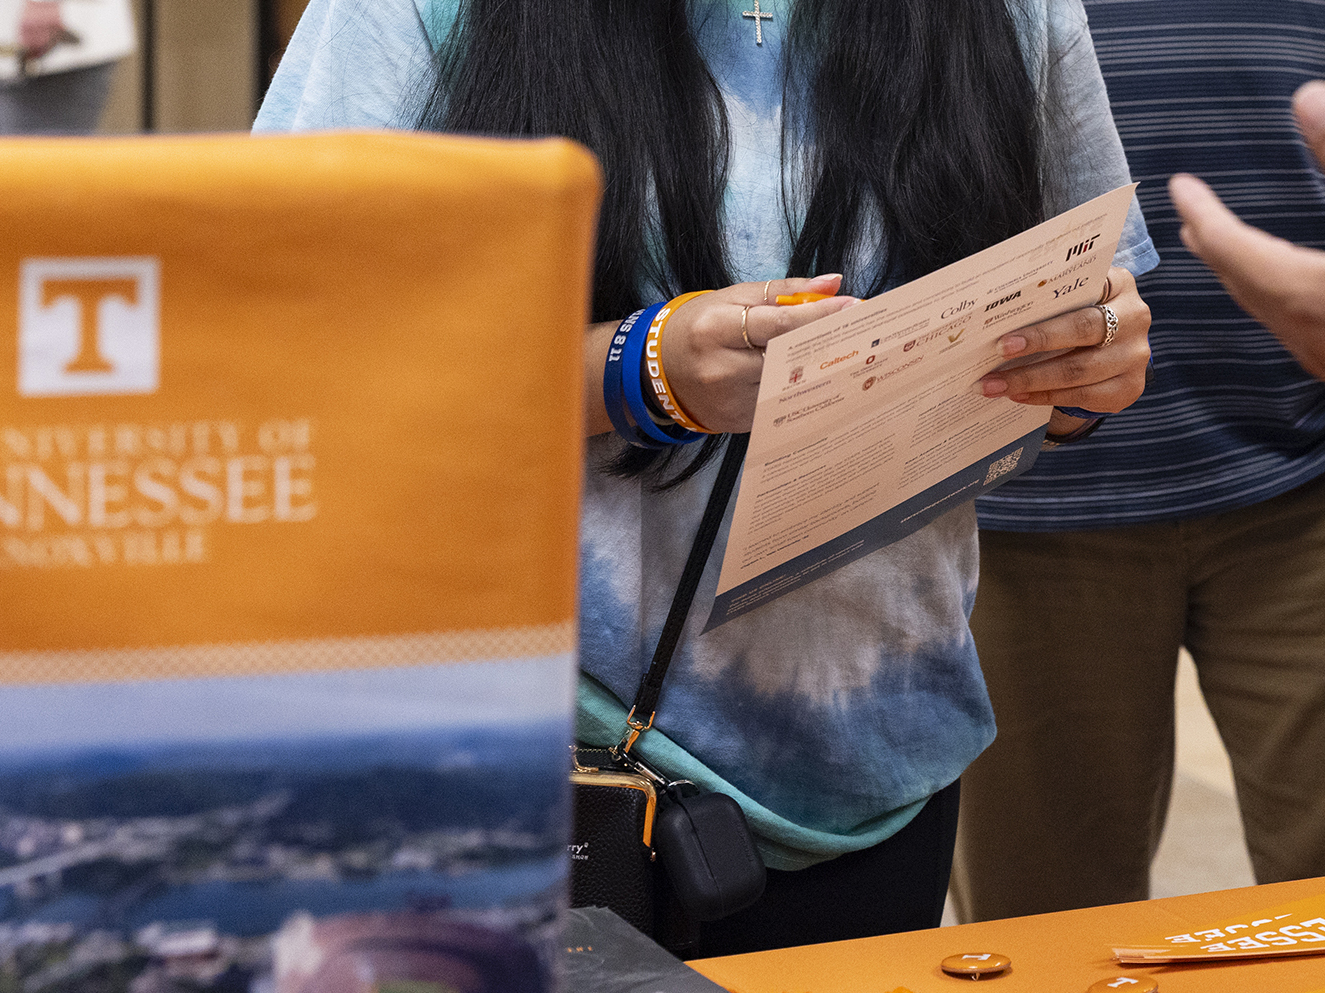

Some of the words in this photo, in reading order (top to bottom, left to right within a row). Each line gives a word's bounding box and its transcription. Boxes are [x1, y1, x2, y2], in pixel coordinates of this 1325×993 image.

[1053, 277, 1089, 299] Yale
[940, 298, 978, 319] Colby
[984, 290, 1021, 312] IOWA
[614, 335, 626, 345] 8
[916, 315, 972, 347] CHICAGO
[646, 308, 686, 428] STUDENT
[819, 350, 859, 370] Caltech
[778, 380, 831, 404] Northwestern
